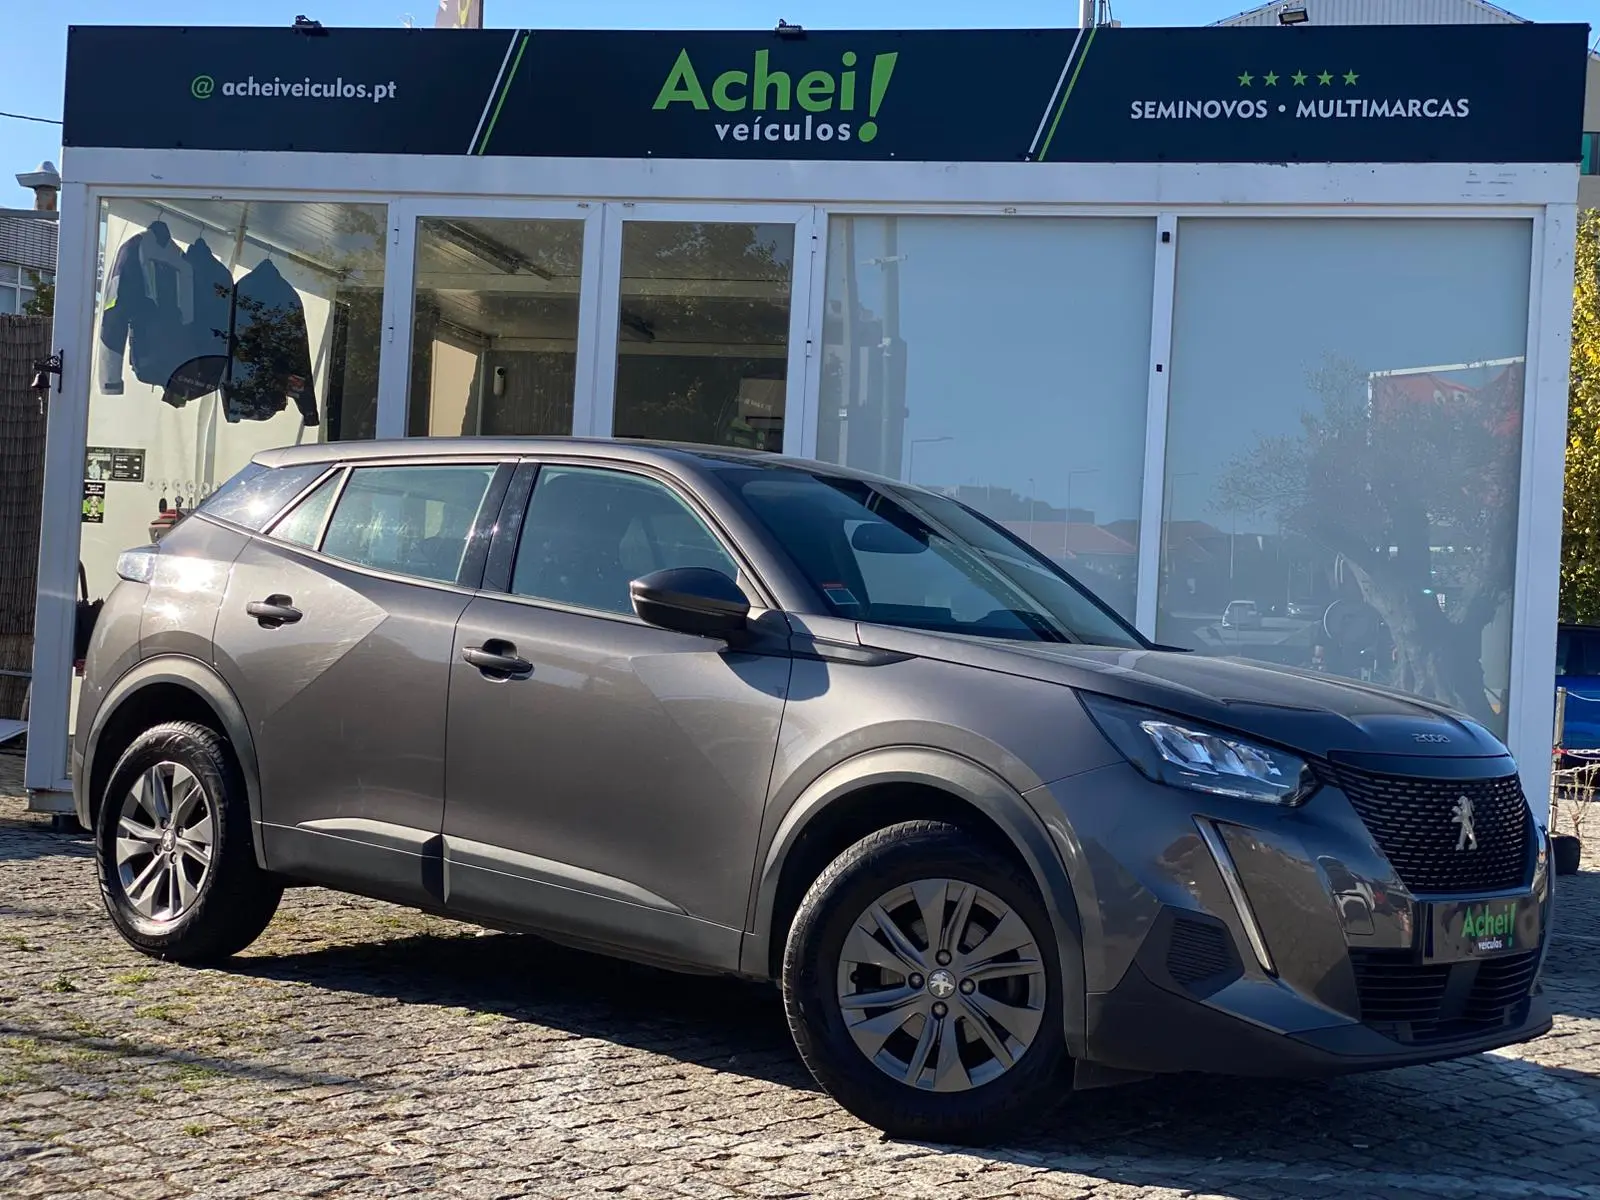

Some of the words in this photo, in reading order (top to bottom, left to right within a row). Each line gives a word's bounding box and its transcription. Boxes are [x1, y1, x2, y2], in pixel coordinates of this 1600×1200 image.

[191, 74, 215, 99] @
[222, 76, 397, 103] acheiveiculos.pt
[652, 48, 898, 142] Achei!
[1130, 100, 1268, 119] SEMINOVOS
[1295, 98, 1470, 118] MULTIMARCAS
[714, 115, 852, 141] veículos
[1461, 903, 1517, 947] Achei!
